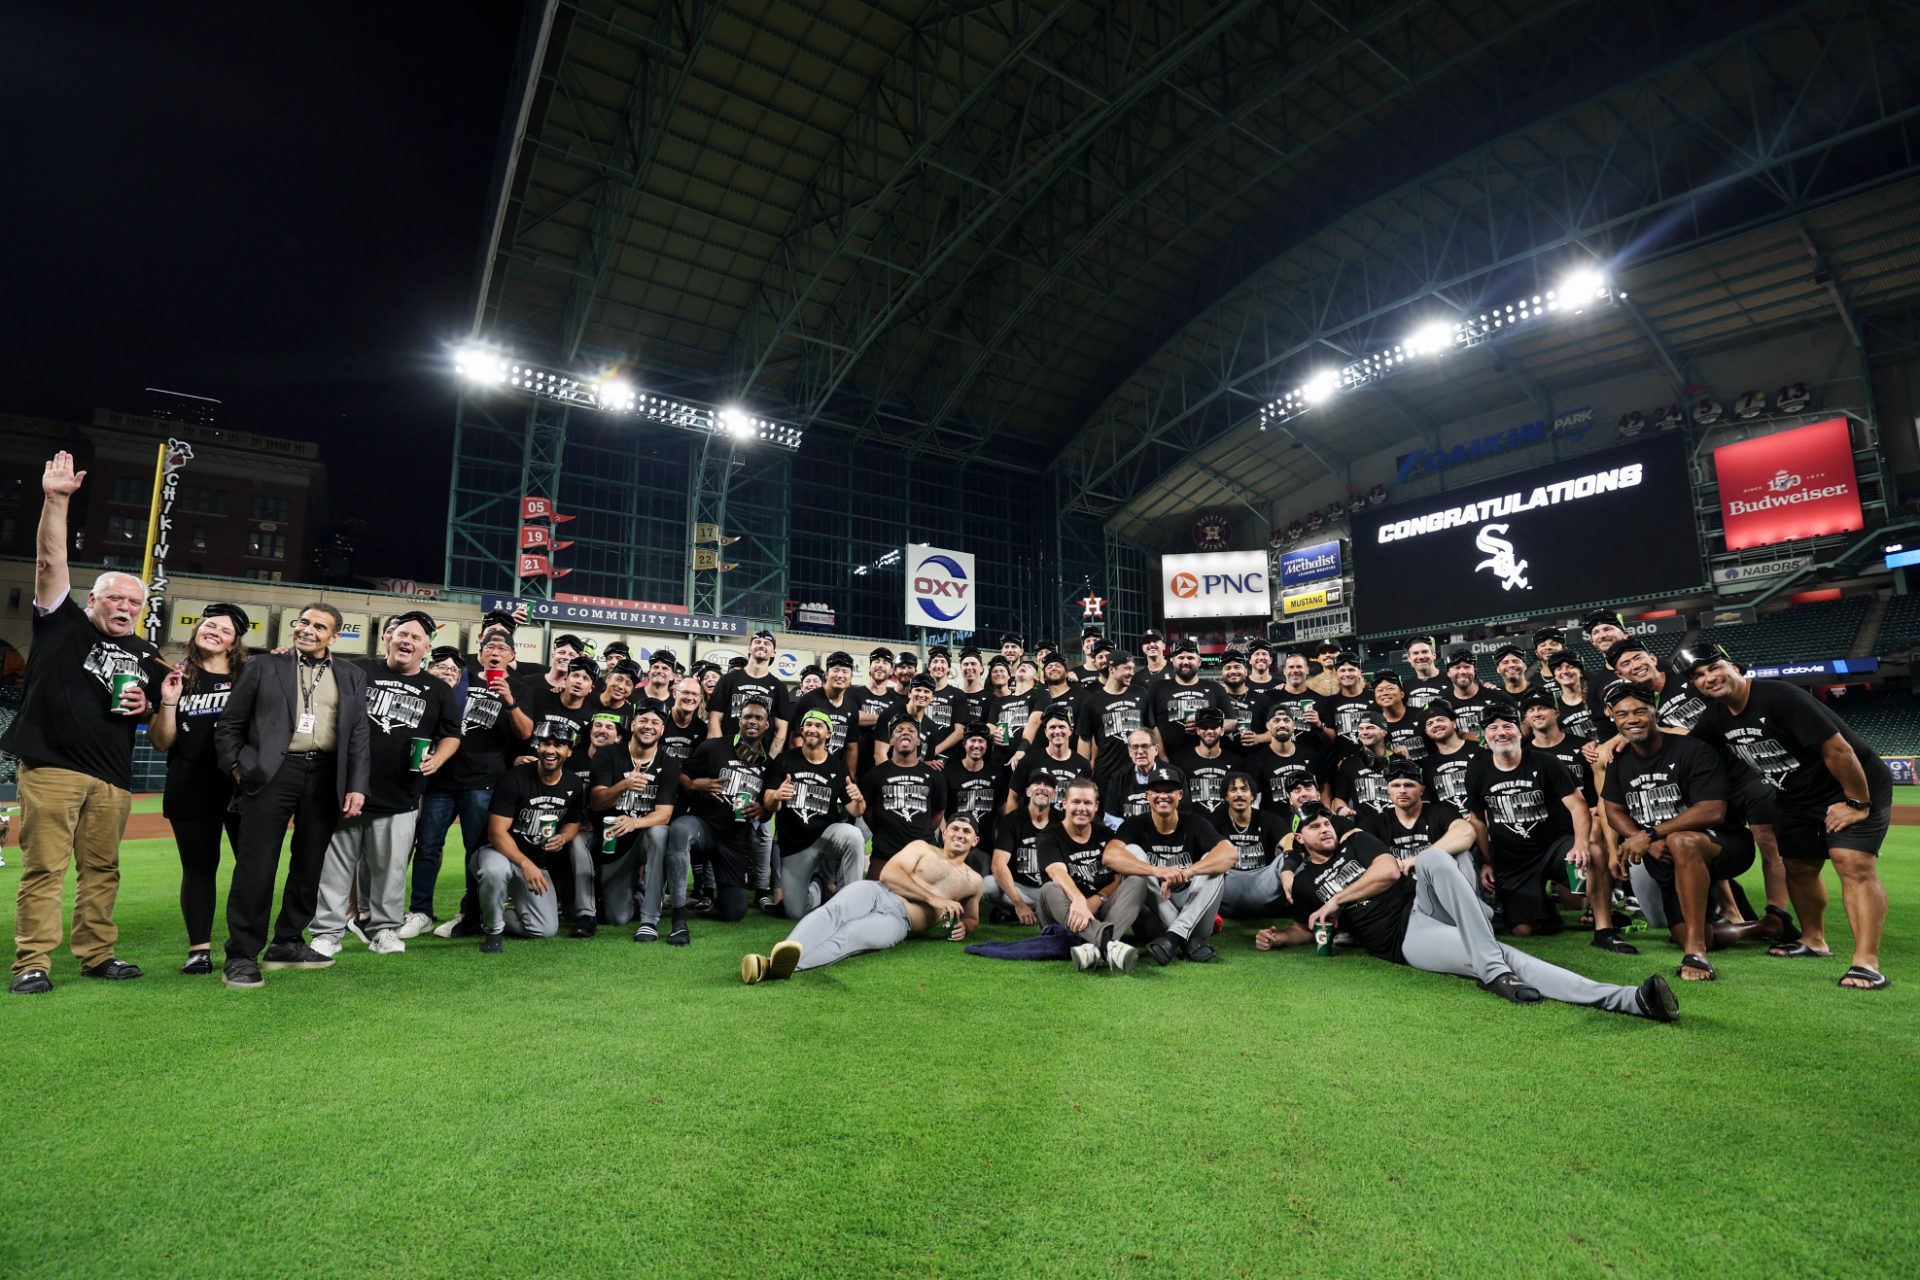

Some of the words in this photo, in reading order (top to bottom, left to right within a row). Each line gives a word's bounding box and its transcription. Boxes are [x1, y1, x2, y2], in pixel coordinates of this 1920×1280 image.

[1424, 421, 1544, 471] DAIKIN
[1554, 409, 1592, 430] PARK
[1378, 464, 1643, 544] CONGRATULATIONS
[1728, 484, 1847, 516] Budweiser
[528, 502, 544, 512] 05
[154, 472, 179, 558] CHIKIN
[528, 532, 543, 542] 19
[701, 528, 712, 537] 17
[524, 560, 540, 570] 21
[700, 556, 712, 564] 22
[1285, 554, 1336, 575] Methodist
[1742, 560, 1800, 577] NABORS
[914, 577, 968, 598] OXY
[1202, 572, 1264, 595] PNC
[1290, 596, 1323, 608] MUSTANG
[1326, 592, 1340, 602] CAT
[568, 607, 666, 624] COMMUNITY
[674, 617, 737, 631] LEADERS
[1304, 624, 1344, 639] HARGROVE
[778, 661, 796, 669] OXY
[1782, 666, 1824, 674] abbvie
[374, 680, 403, 688] WHITE
[1490, 780, 1514, 792] WHITE
